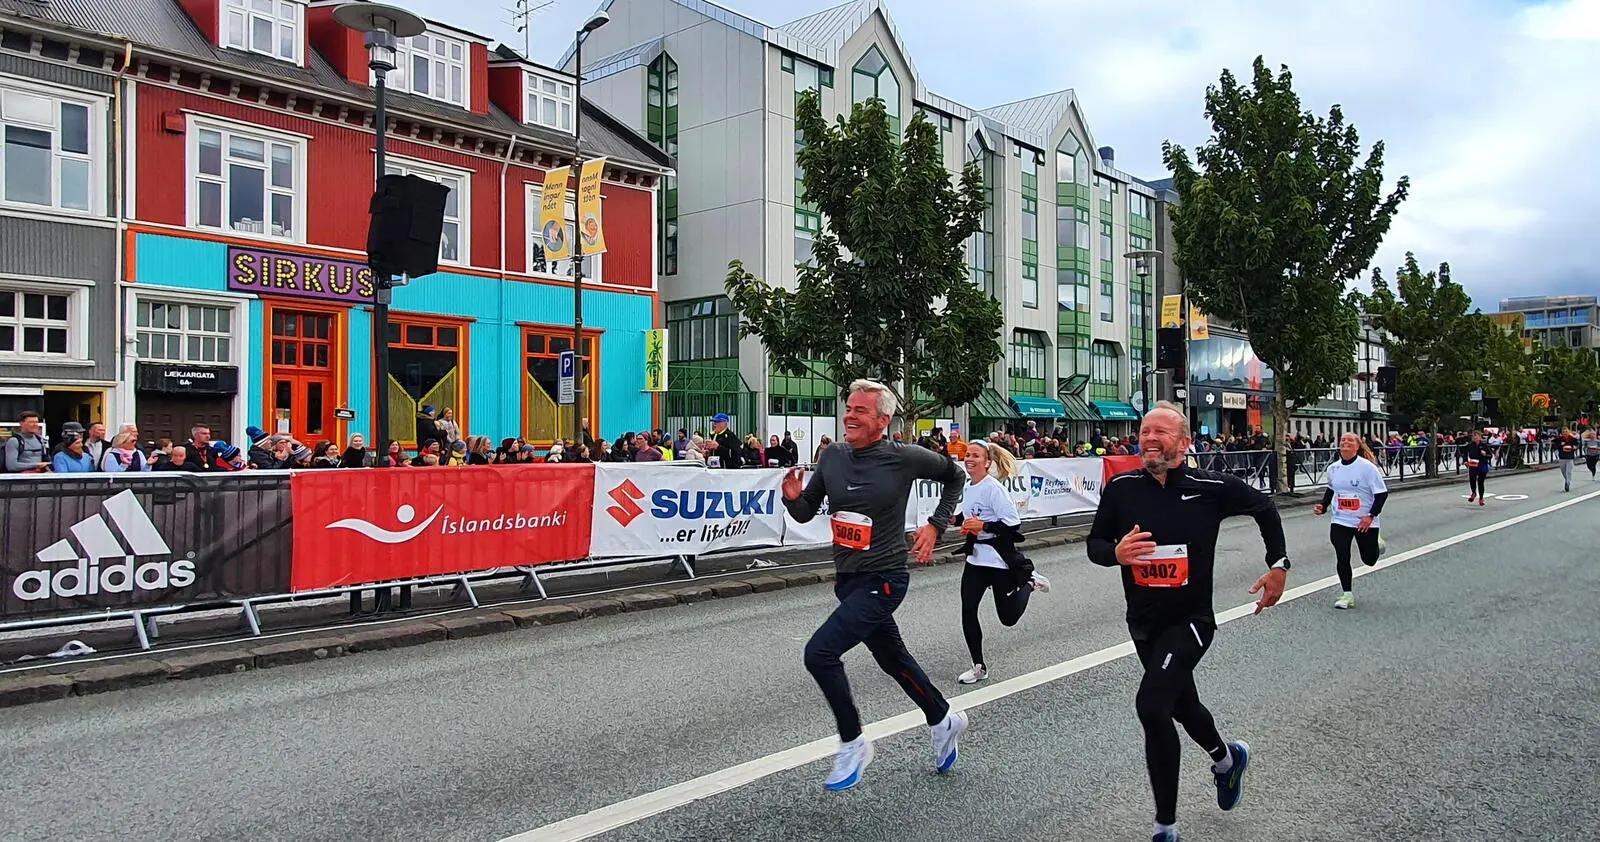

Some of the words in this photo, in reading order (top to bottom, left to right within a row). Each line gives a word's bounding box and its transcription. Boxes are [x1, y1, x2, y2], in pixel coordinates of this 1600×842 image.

[233, 253, 376, 297] SIRKUS
[563, 357, 571, 374] P
[651, 489, 776, 519] SUZUKI
[441, 510, 567, 534] Íslandsbanki
[835, 525, 862, 542] 5086
[13, 555, 196, 601] adidas
[1141, 563, 1178, 579] 3402
